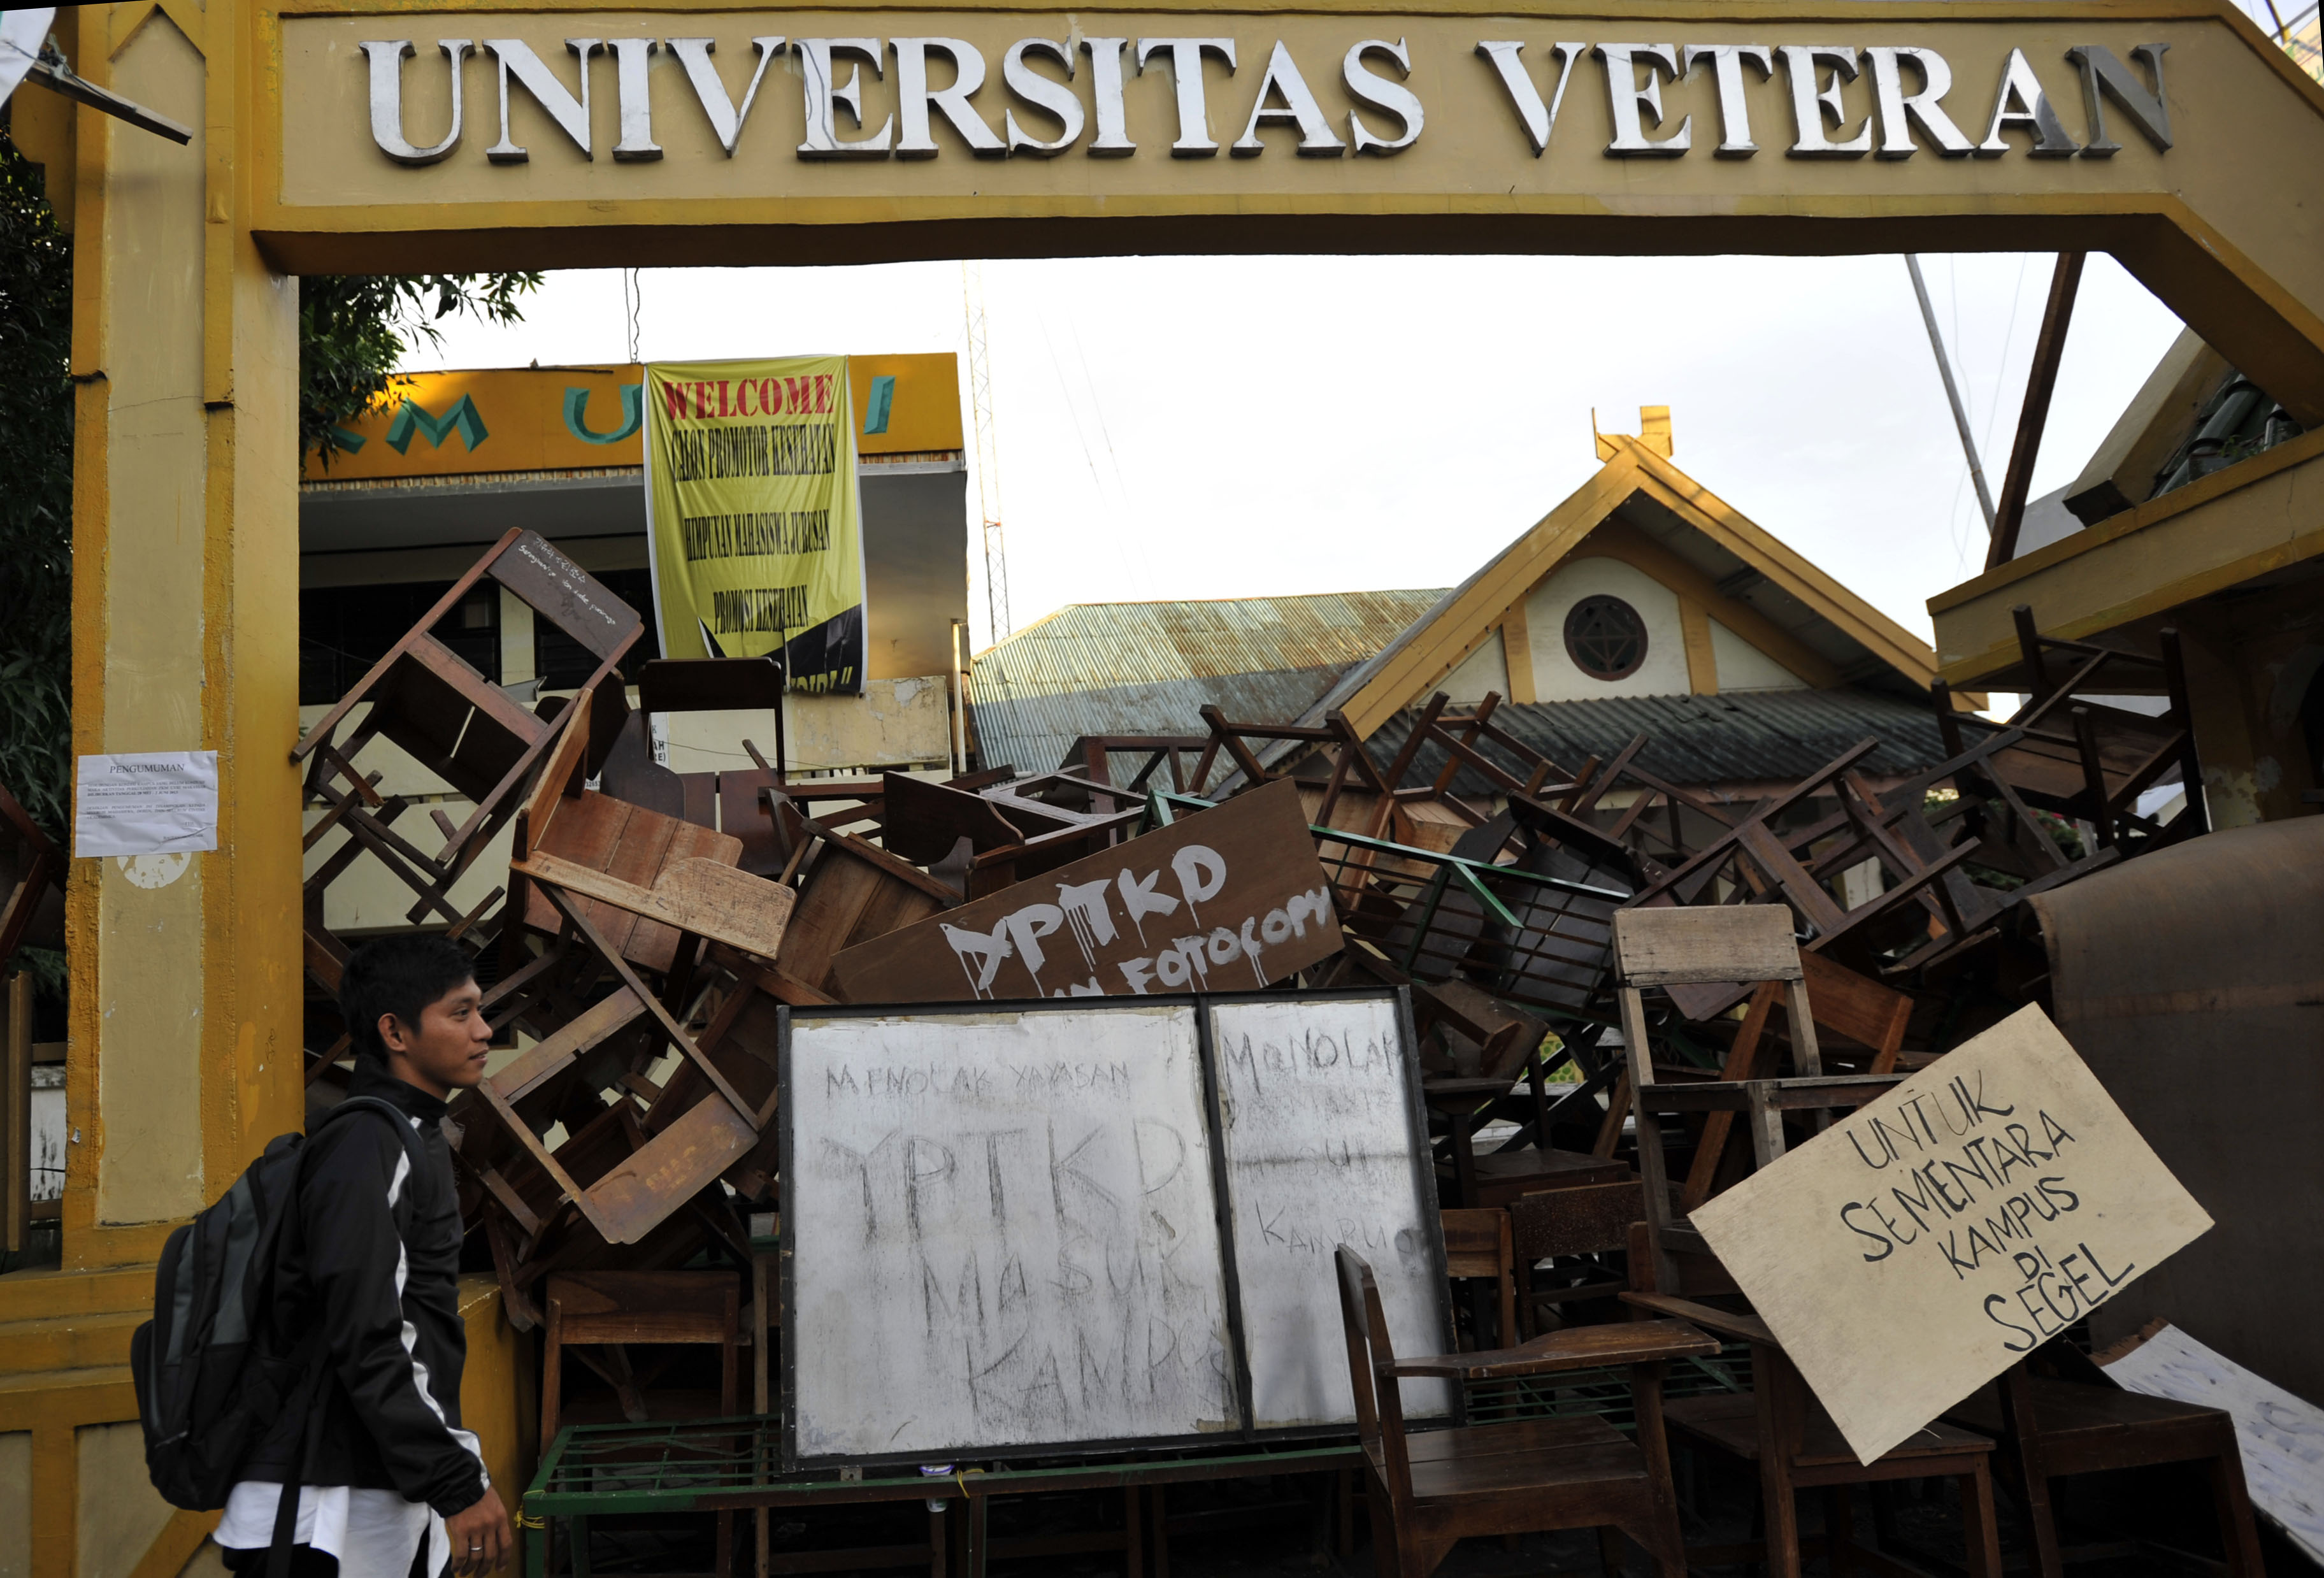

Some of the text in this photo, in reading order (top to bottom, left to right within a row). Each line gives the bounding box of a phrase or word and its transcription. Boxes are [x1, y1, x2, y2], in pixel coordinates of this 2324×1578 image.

[358, 36, 1424, 167] UNIVERSITAS
[1474, 39, 2176, 161] VETERAN
[663, 374, 834, 420] WELCOME
[671, 423, 835, 483] CALON PROMOTOR KESEHATAN
[684, 508, 831, 562] HIMPUNAN MAHASISWA JURUSAN
[713, 584, 809, 635] PROMOSI KESEHATAN
[110, 763, 185, 774] PENGUMUMAN
[940, 844, 1228, 991] YPTKD
[1846, 1070, 2014, 1169] UNTUK
[1840, 1108, 2076, 1263] SEMENTARA
[1937, 1177, 2081, 1280] KAMPUS
[2013, 1244, 2053, 1284] DI
[1983, 1242, 2135, 1352] SEGEL
